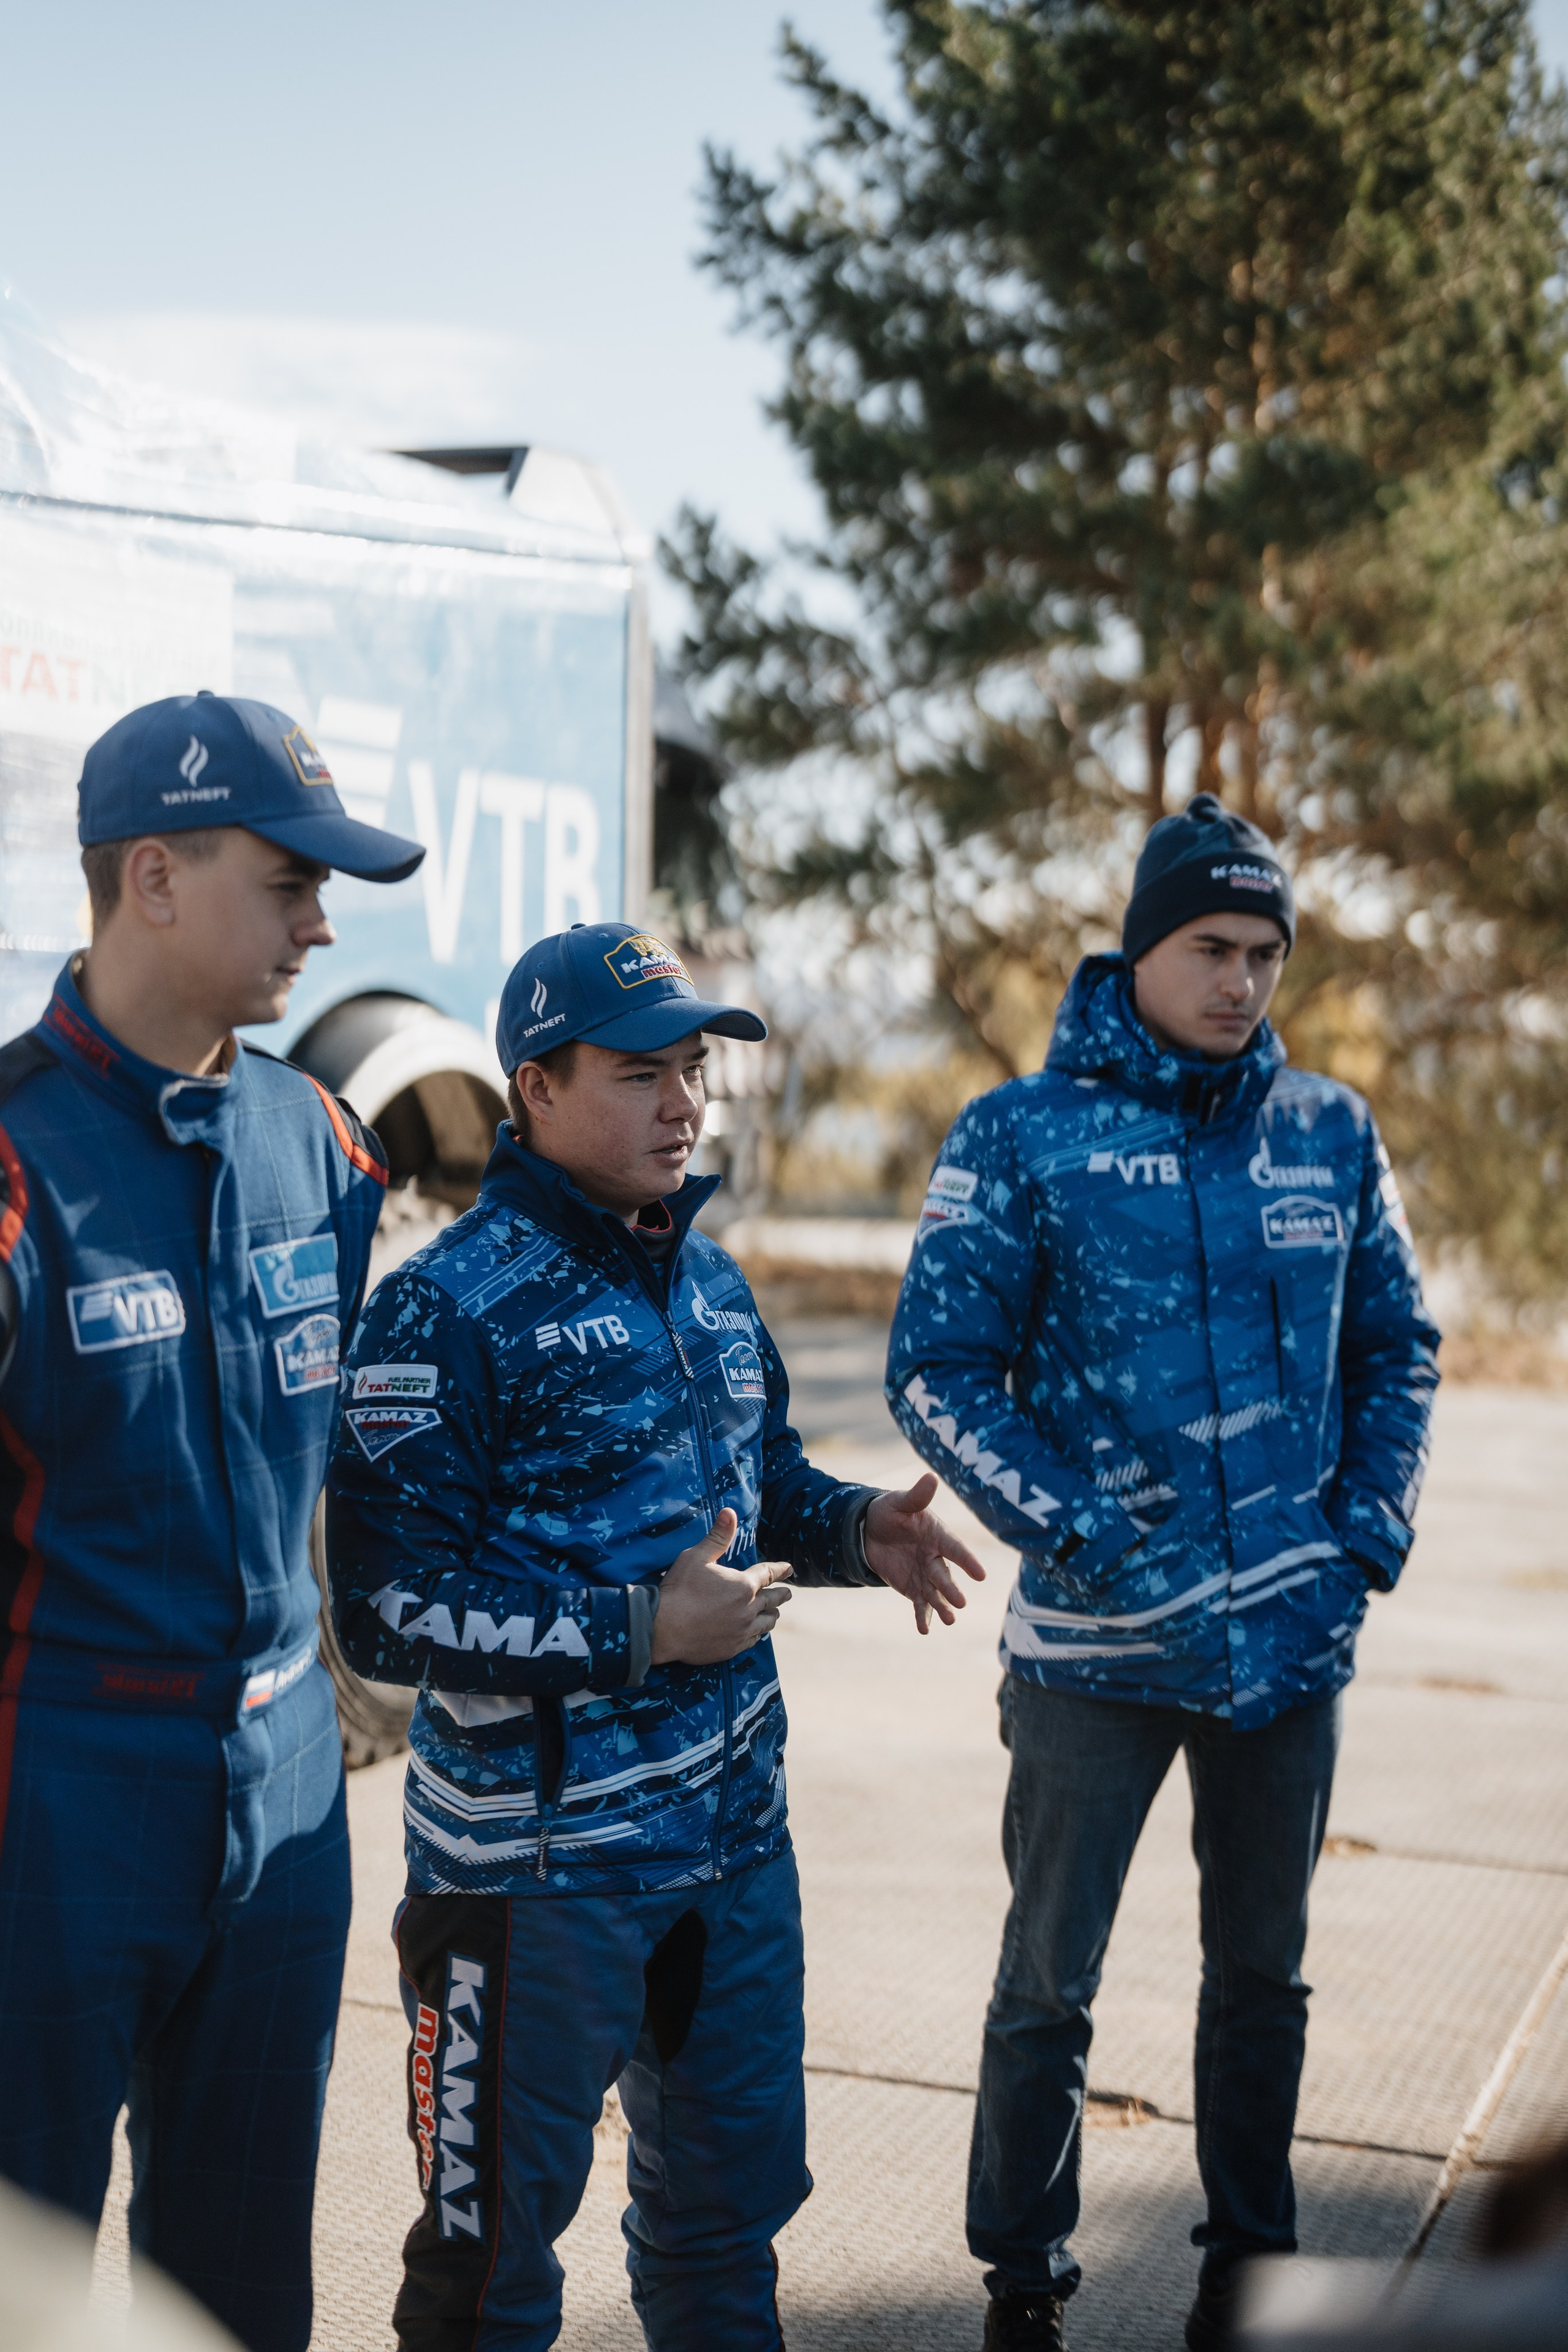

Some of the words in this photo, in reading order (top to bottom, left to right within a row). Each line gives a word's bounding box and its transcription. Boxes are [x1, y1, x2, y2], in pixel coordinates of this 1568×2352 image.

[407, 759, 602, 967] VTB
[523, 1013, 565, 1038] TATNEFT
[1115, 1153, 1180, 1185] VTB
[113, 1287, 179, 1334] VTB
[561, 1314, 630, 1355] VTB
[735, 1346, 754, 1366] Team
[368, 1384, 430, 1393] TATNEFT
[353, 1411, 428, 1425] KAMAZ
[361, 1419, 410, 1430] master
[904, 1374, 1062, 1529] KAMAZ
[412, 2002, 440, 2191] master
[439, 1956, 484, 2239] KAMAZ
